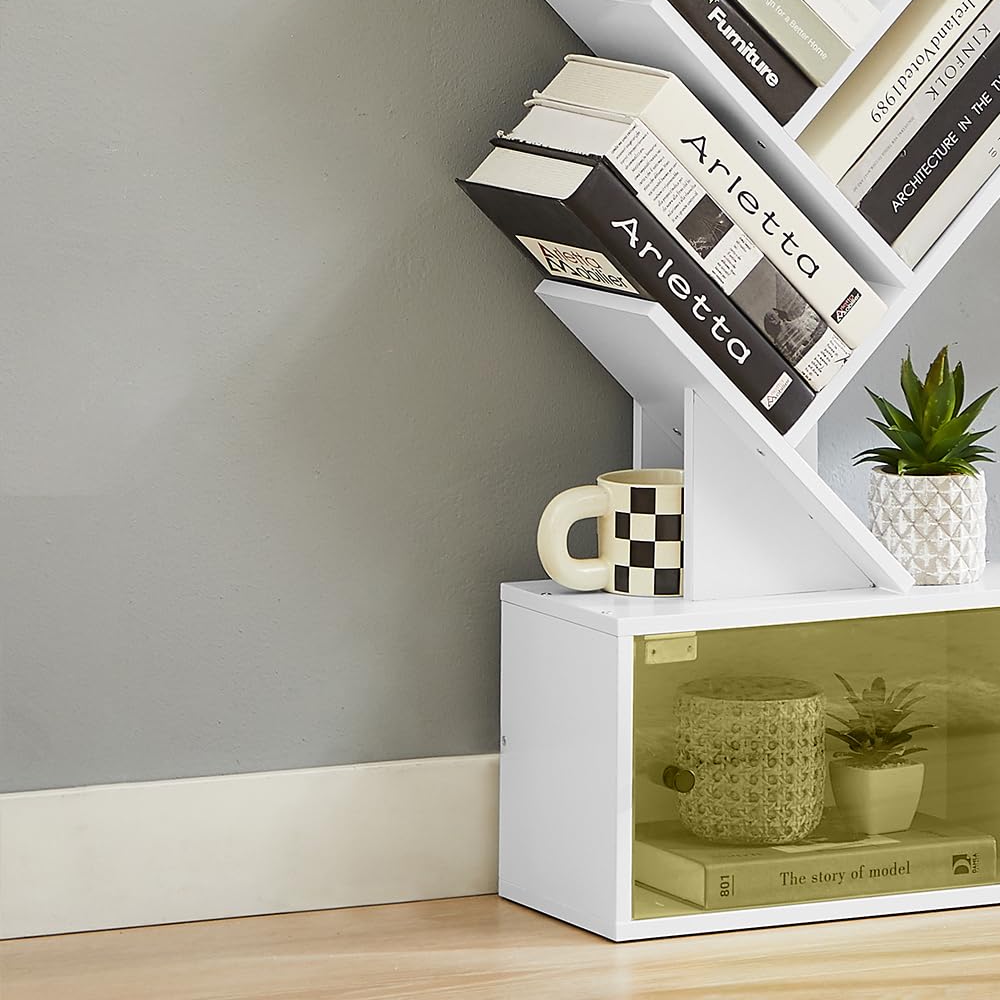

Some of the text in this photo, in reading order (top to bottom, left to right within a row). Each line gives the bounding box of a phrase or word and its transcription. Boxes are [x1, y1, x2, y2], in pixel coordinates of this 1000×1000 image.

[707, 6, 779, 87] Furniture
[775, 4, 788, 18] for
[788, 20, 809, 42] Better
[807, 37, 829, 60] Home
[925, 23, 992, 101] KINFOLK
[891, 130, 959, 213] ARCHITECTURE
[957, 115, 973, 134] IN
[970, 91, 993, 116] THE
[680, 134, 820, 279] Arletta
[538, 242, 603, 270] Arletta
[545, 258, 628, 288] Mobilier
[611, 217, 752, 365] Arletta
[720, 875, 730, 897] 801
[780, 861, 910, 886] The story of model
